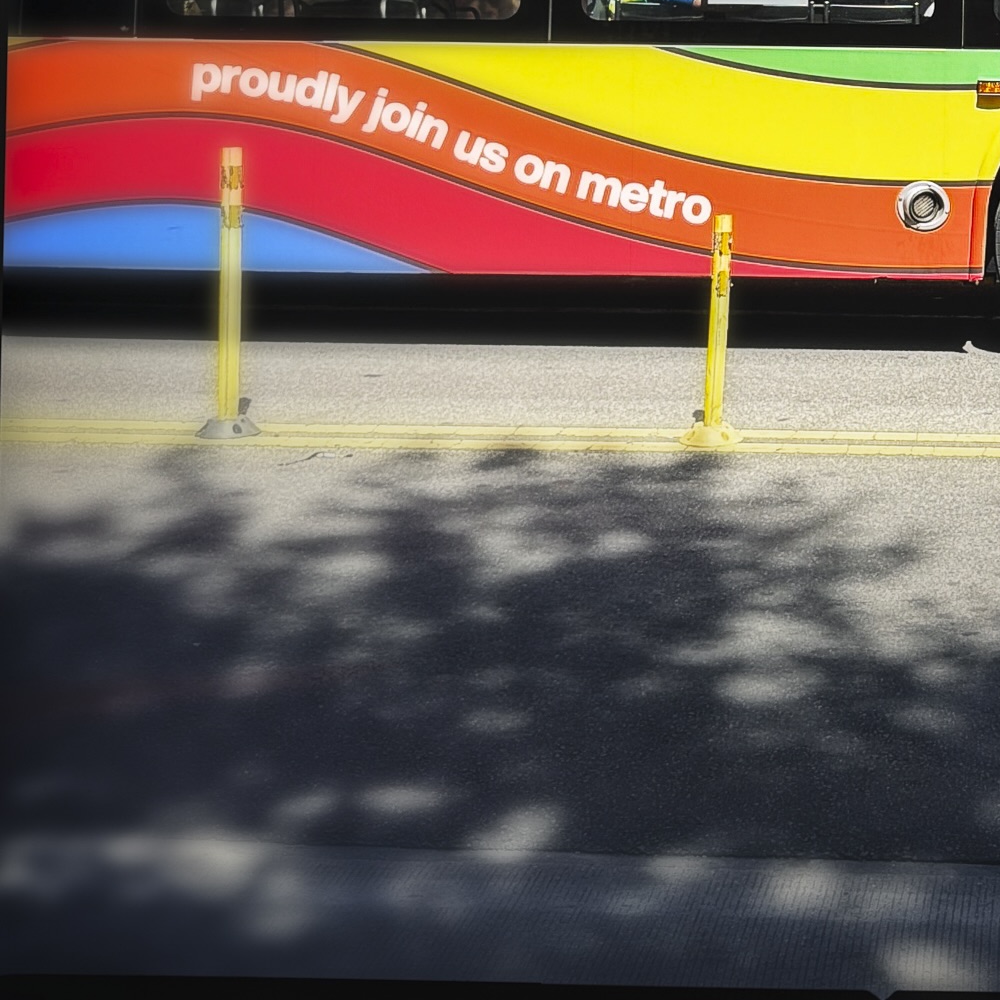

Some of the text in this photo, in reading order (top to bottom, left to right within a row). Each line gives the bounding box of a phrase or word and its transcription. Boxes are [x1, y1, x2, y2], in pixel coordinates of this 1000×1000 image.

[190, 61, 713, 227] proudly join us on metro
